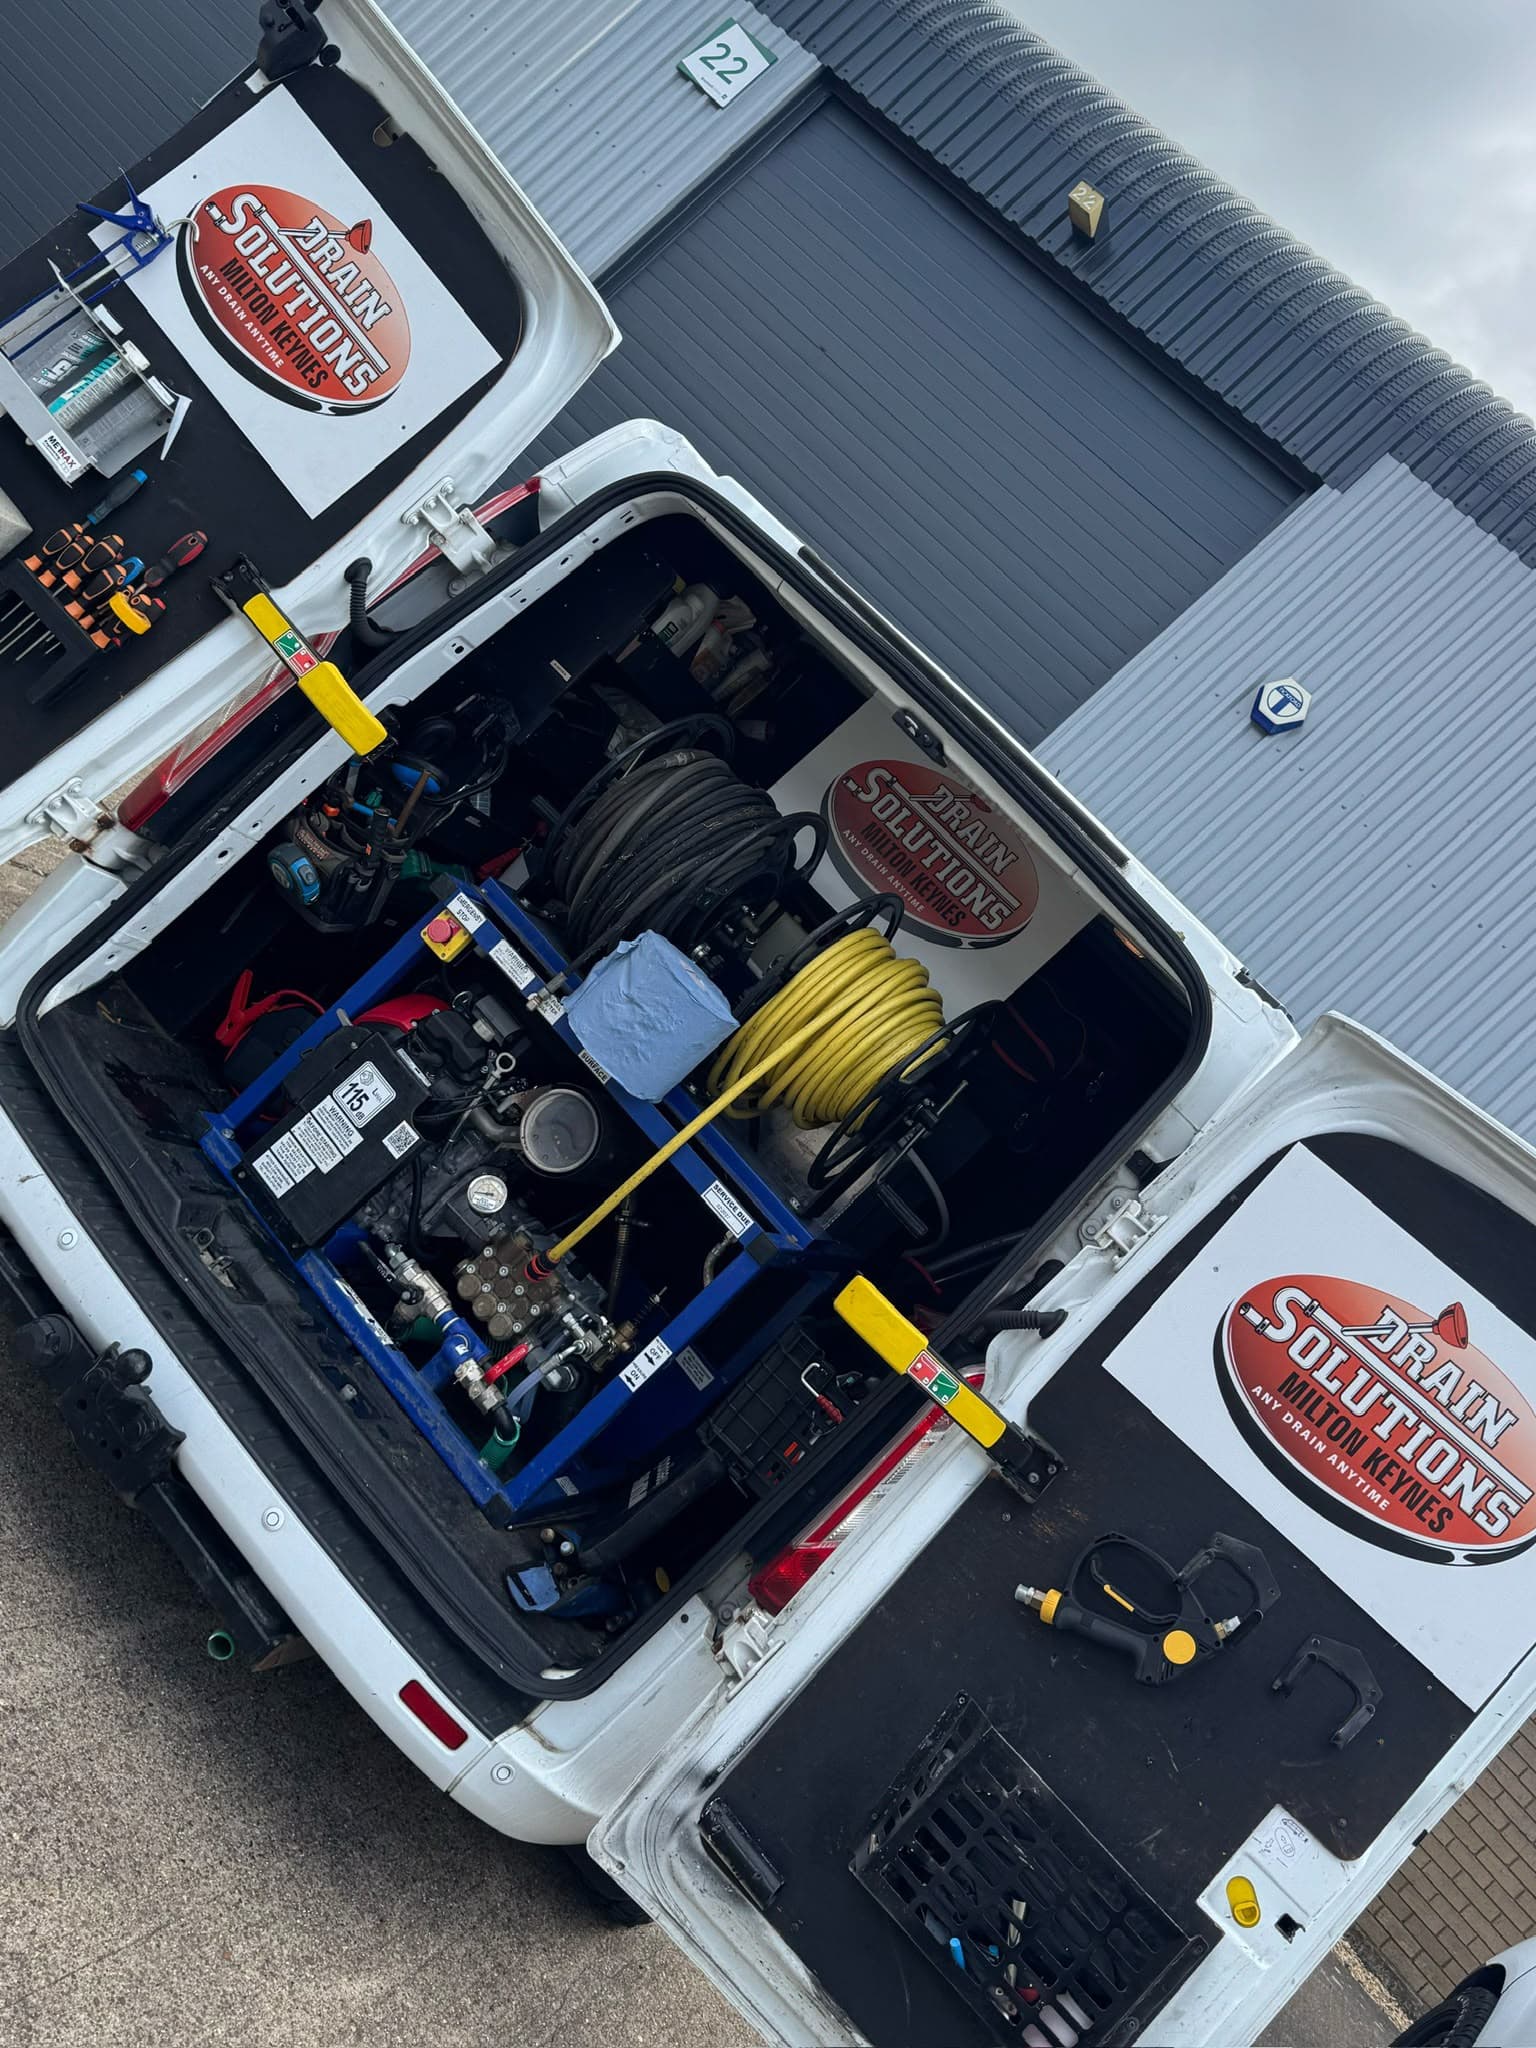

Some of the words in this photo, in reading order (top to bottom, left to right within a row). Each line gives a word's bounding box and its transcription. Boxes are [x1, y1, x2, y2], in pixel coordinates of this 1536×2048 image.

[699, 43, 747, 85] 22
[1072, 187, 1096, 211] 22
[200, 265, 221, 286] ANY
[218, 286, 246, 321] DRAIN
[244, 322, 284, 369] ANYTIME
[205, 192, 380, 396] SOLUTIONS
[296, 216, 392, 331] DRAIN
[219, 257, 280, 325] MILTON
[269, 319, 328, 389] KEYNES
[843, 767, 1013, 930] SOLUTIONS
[843, 830, 861, 848] ANY
[861, 848, 888, 875] DRAIN
[887, 875, 924, 912] ANYTIME
[927, 784, 1019, 876] DRAIN
[456, 909, 470, 923] STOP
[861, 822, 916, 878] MILTON
[910, 872, 966, 927] KEYNES
[342, 1083, 370, 1110] 115
[581, 1052, 608, 1082] SURFACE
[329, 1106, 356, 1138] WARNING
[355, 1110, 366, 1121] dB
[713, 1184, 739, 1213] SERVICE
[737, 1211, 751, 1226] DUE
[630, 1370, 641, 1381] ON
[649, 1348, 662, 1361] OFF
[1367, 1305, 1519, 1449] DRAIN
[1239, 1286, 1523, 1537] SOLUTIONS
[1251, 1384, 1282, 1411] ANY
[1282, 1412, 1327, 1453] DRAIN
[1327, 1453, 1390, 1511] ANYTIME
[1278, 1372, 1368, 1457] MILTON
[1362, 1447, 1453, 1533] KEYNES
